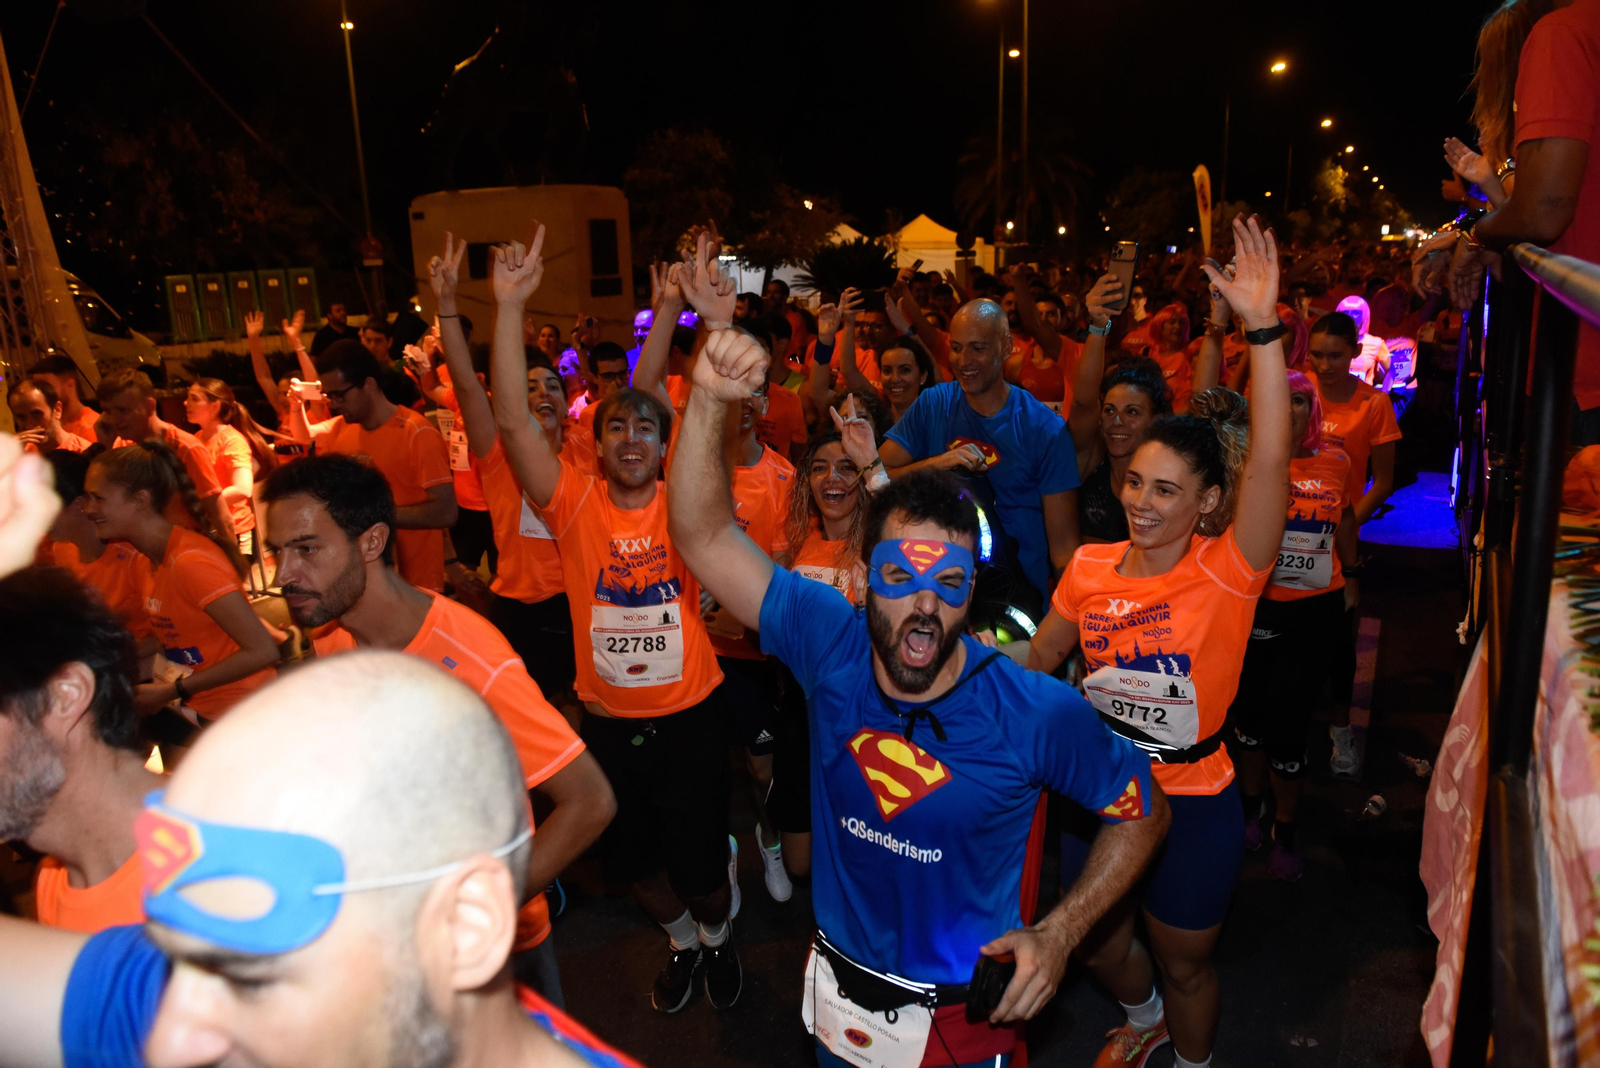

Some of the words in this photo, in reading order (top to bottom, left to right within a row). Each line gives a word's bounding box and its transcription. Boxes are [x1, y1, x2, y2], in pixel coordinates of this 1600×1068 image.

[606, 635, 667, 653] 22788
[1252, 628, 1272, 637] NIKE
[1112, 699, 1168, 725] 9772
[842, 816, 944, 863] +QSenderismo
[824, 999, 853, 1017] SALVADOR
[853, 1013, 877, 1030] CASTILLO
[878, 1027, 900, 1044] POSADA
